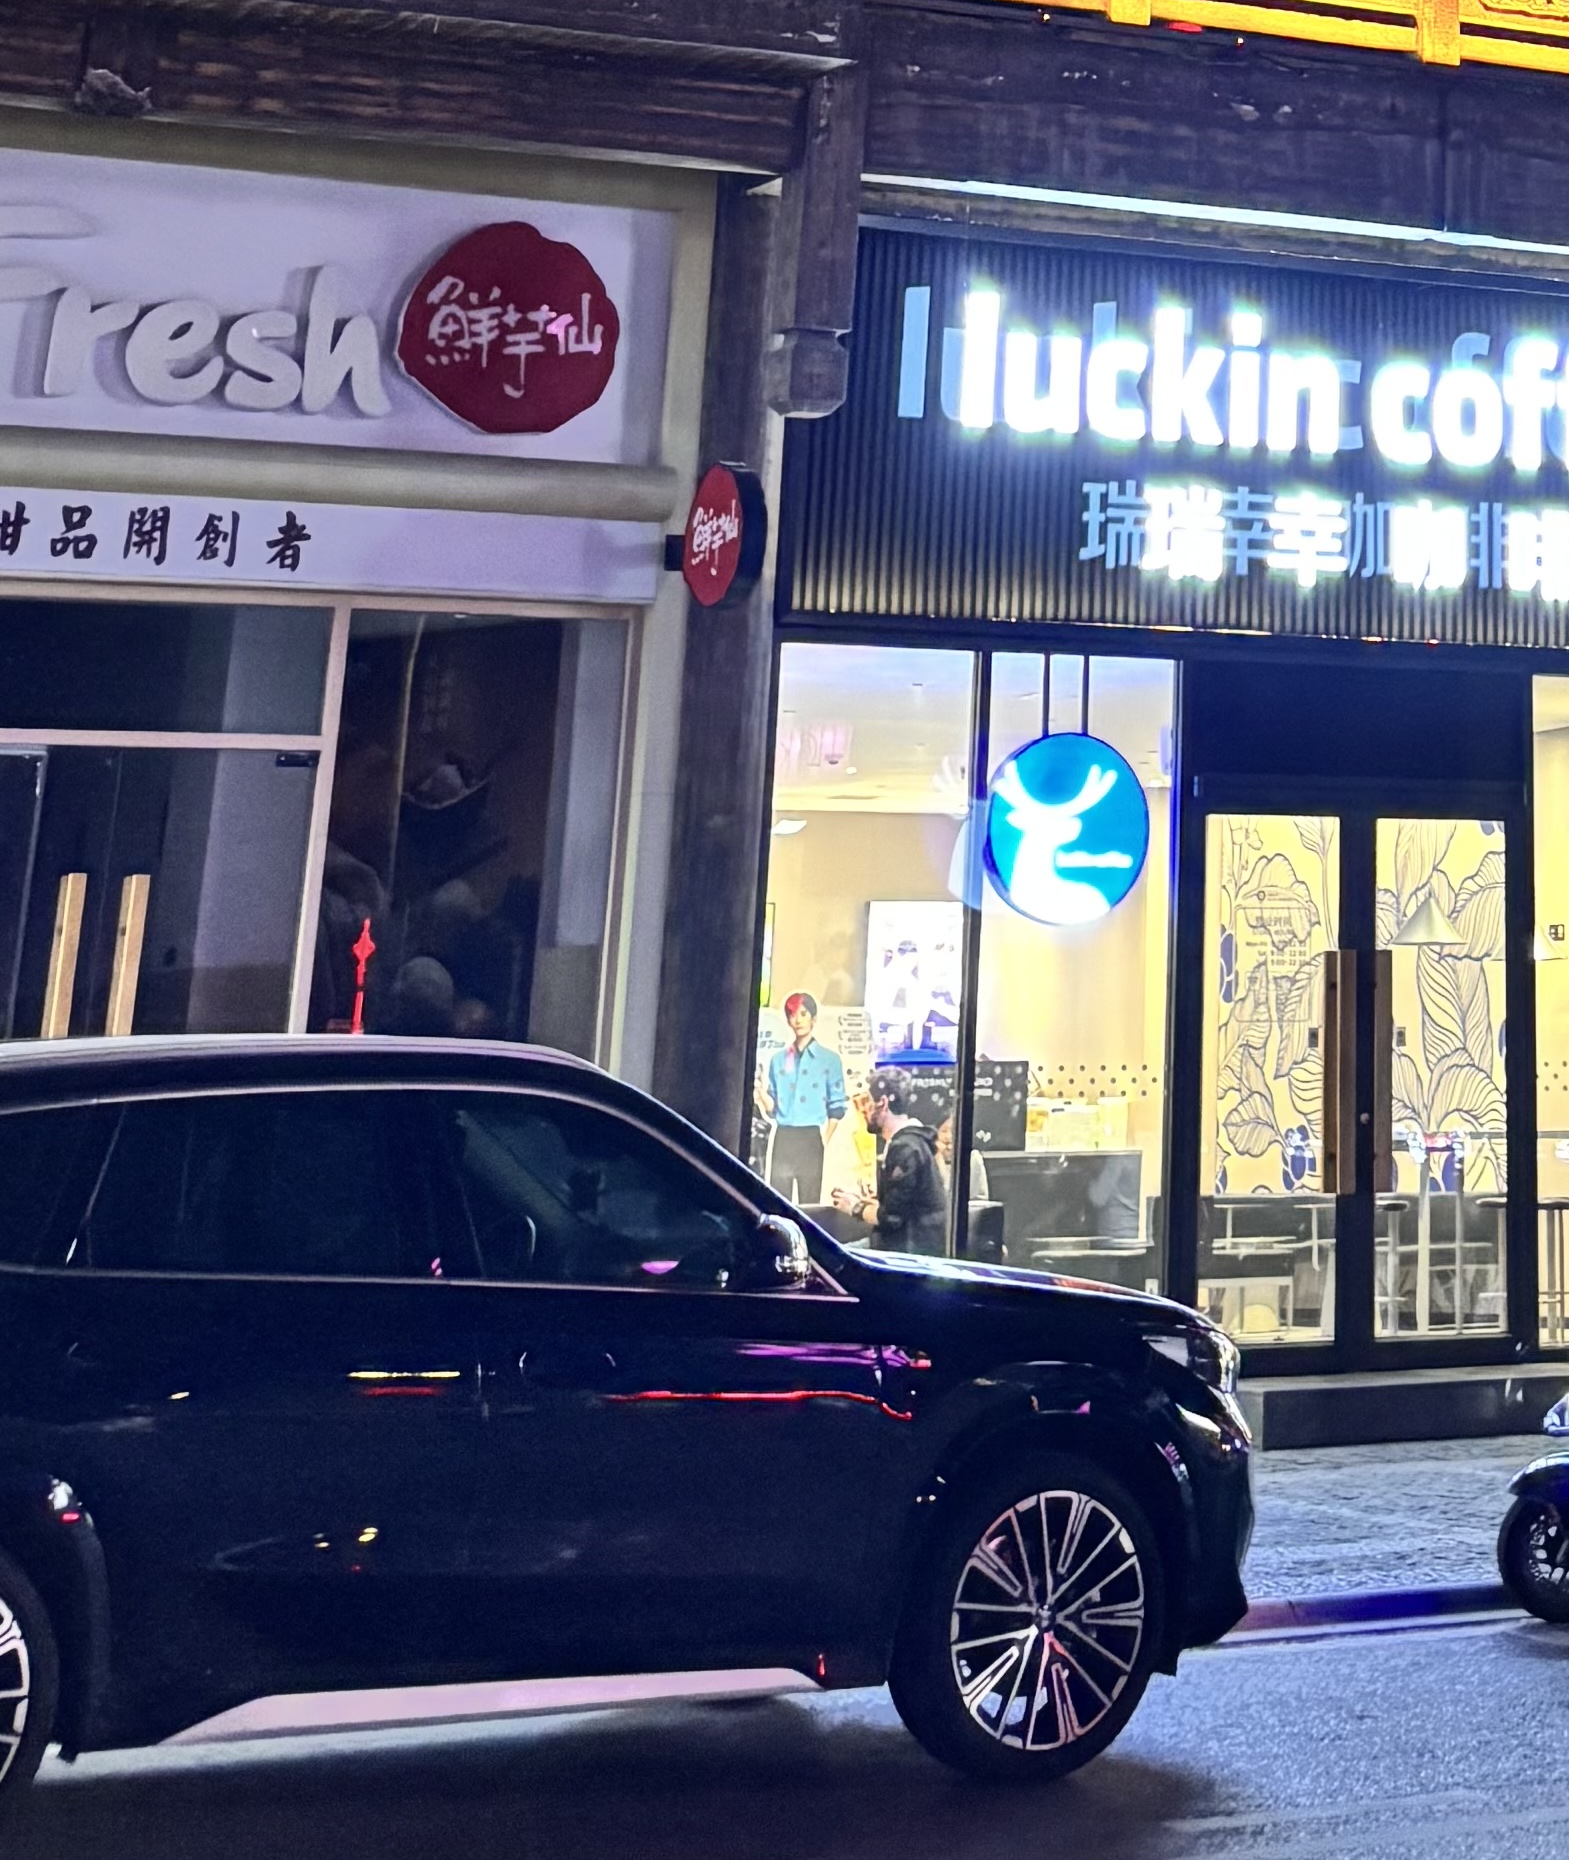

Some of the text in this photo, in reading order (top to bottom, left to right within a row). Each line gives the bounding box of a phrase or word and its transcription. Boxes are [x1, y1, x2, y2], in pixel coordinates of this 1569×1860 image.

[425, 275, 604, 399] 鮮芋仙
[957, 288, 1348, 458] luckin
[690, 498, 740, 577] 鮮芋仙
